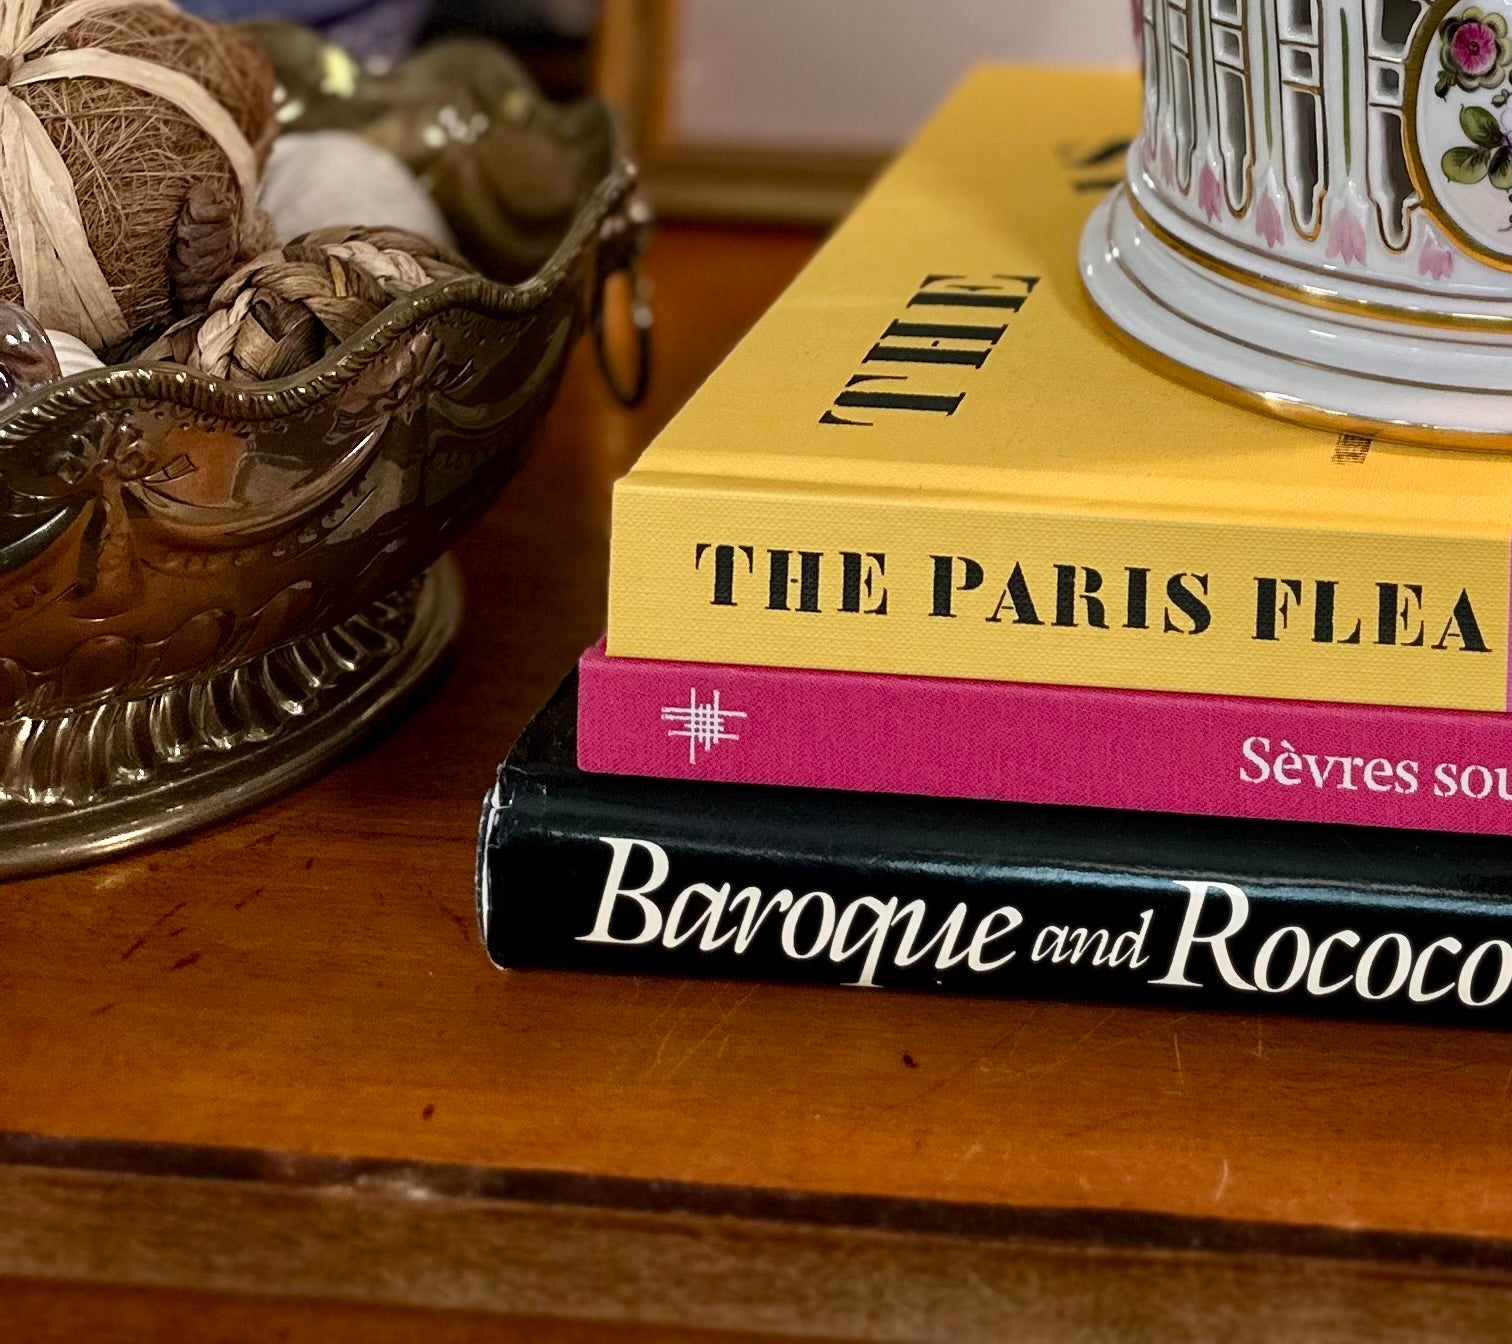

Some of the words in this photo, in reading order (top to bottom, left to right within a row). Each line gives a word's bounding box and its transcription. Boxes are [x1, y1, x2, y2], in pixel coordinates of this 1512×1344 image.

[819, 274, 1041, 426] THE
[694, 542, 888, 616] THE
[929, 554, 1212, 634] PARIS
[1252, 577, 1493, 653] FLEA
[1239, 736, 1419, 795] Sèvres
[574, 836, 1024, 988] Baroque
[1031, 909, 1154, 968] and
